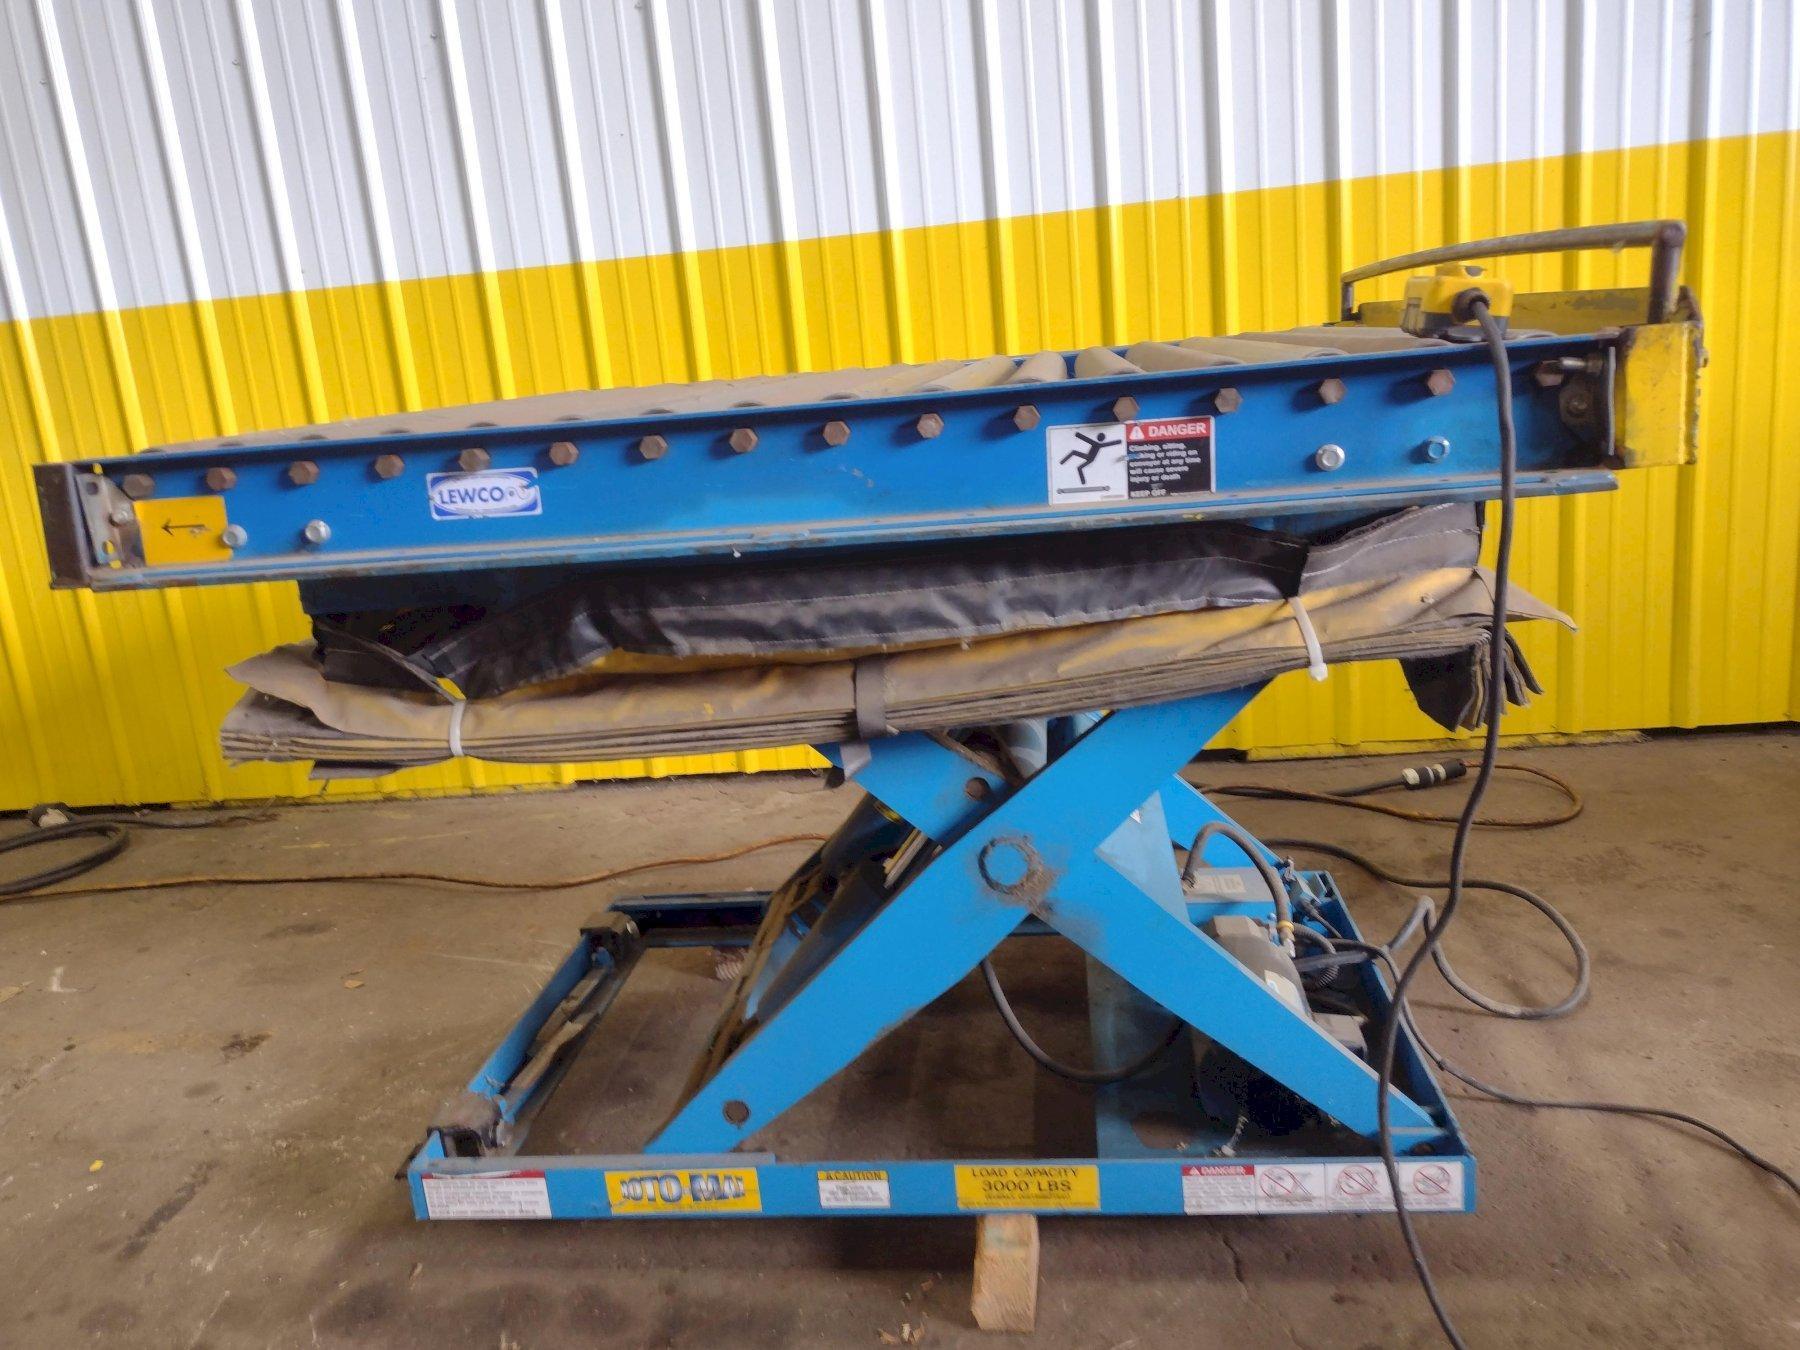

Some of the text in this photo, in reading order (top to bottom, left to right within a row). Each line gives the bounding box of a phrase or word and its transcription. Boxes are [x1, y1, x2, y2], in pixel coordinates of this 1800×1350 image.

[1148, 422, 1207, 437] DANGER
[439, 486, 504, 505] LEWCO
[971, 1167, 1079, 1177] LOAD CAPACITY
[981, 1179, 1072, 1192] 3000 LBS
